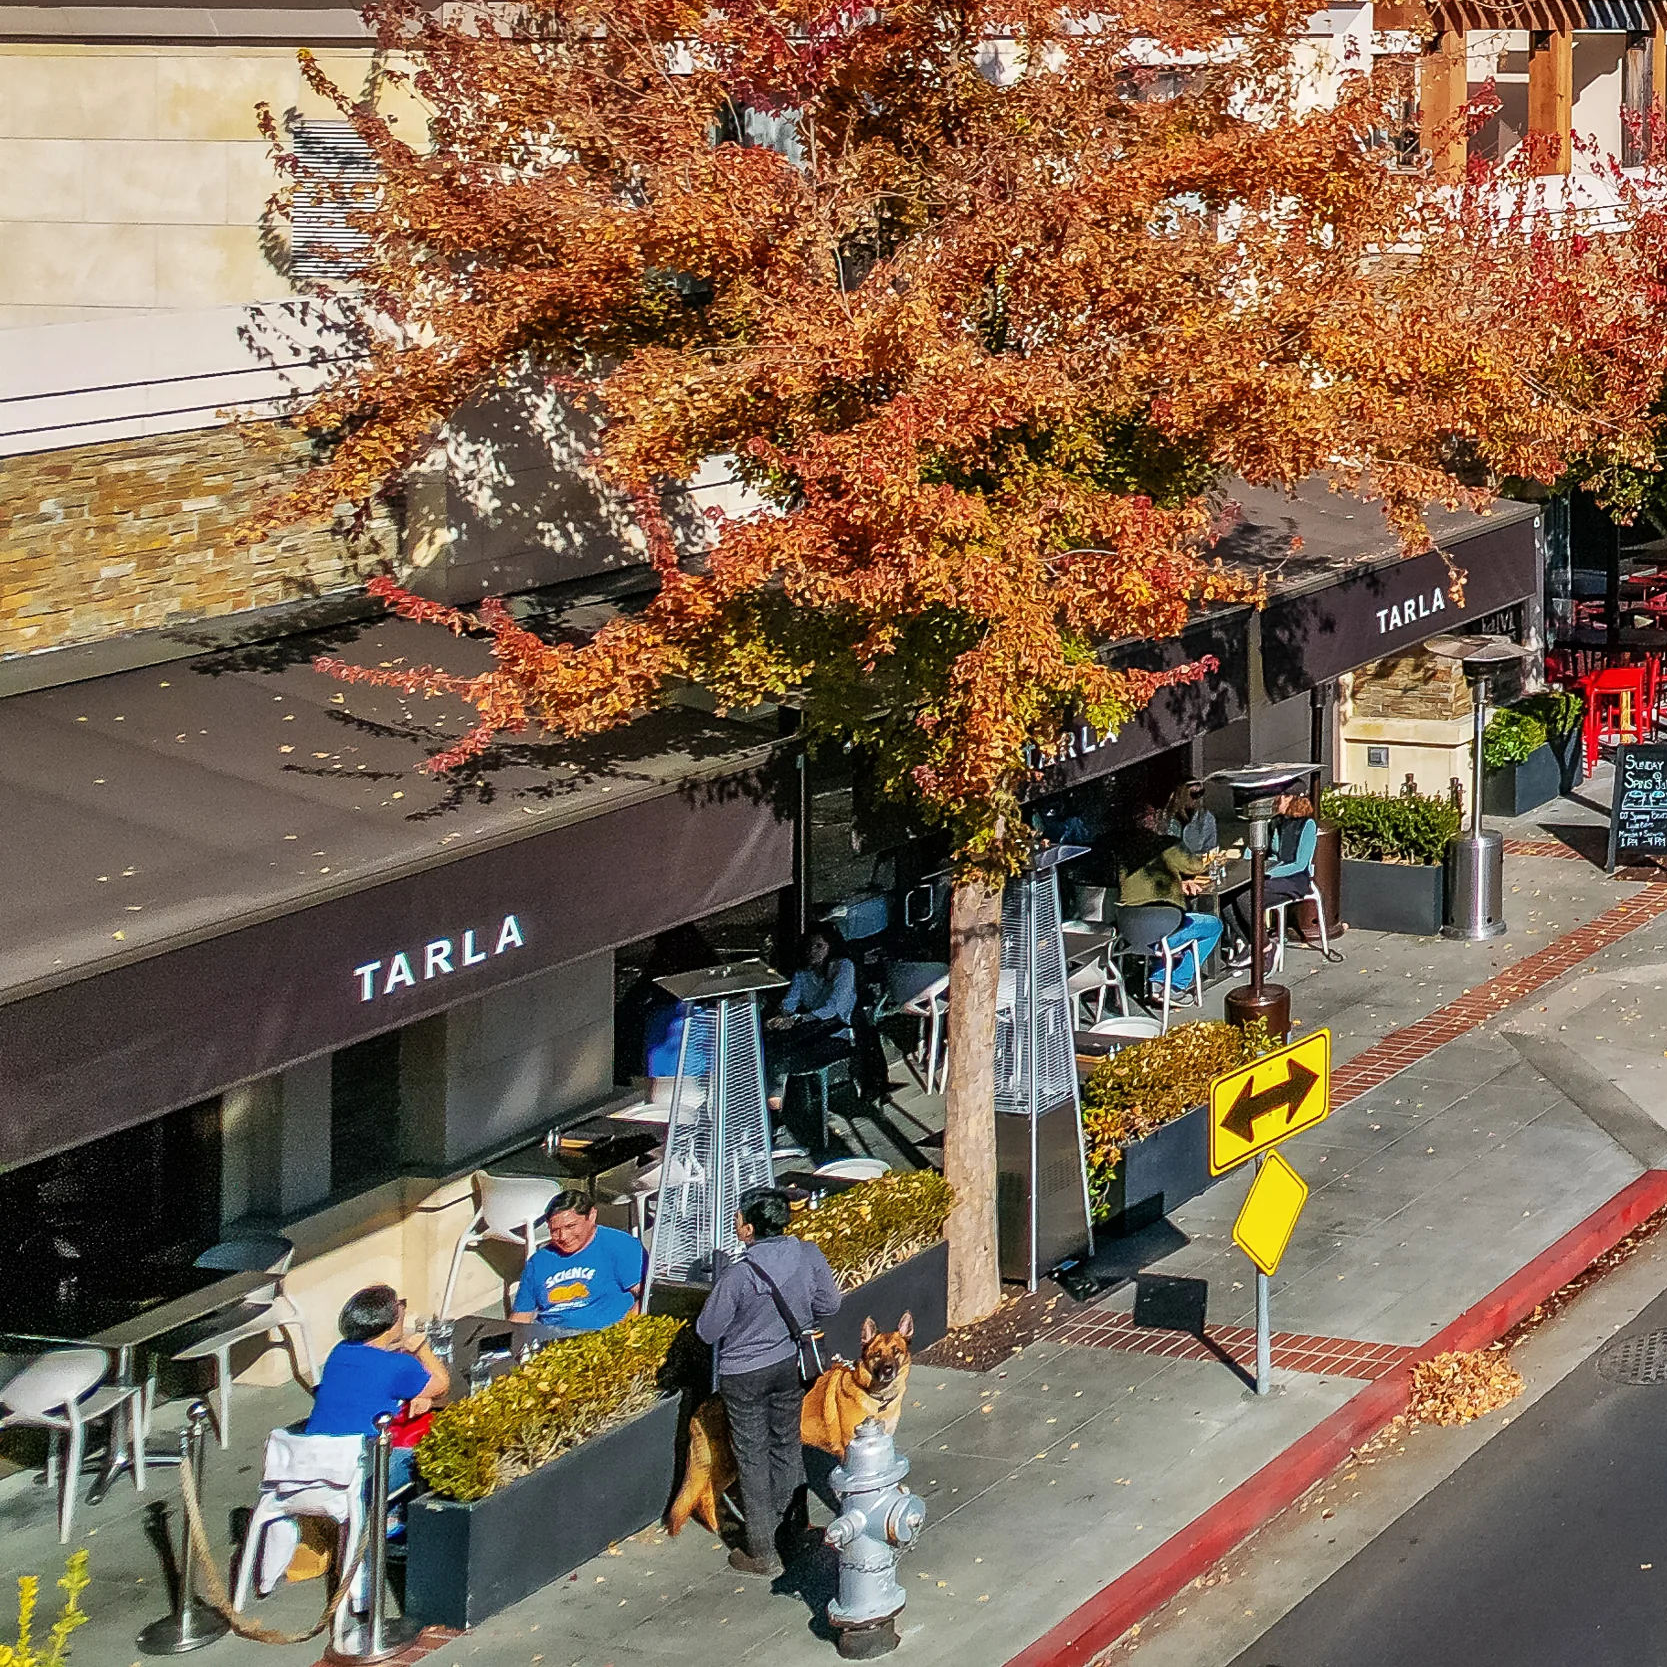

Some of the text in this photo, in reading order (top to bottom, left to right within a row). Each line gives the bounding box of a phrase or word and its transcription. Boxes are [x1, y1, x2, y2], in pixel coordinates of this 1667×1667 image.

[1376, 587, 1446, 634] TARLA
[353, 914, 525, 1003] TARLA
[546, 1266, 597, 1289] SCIENCE
